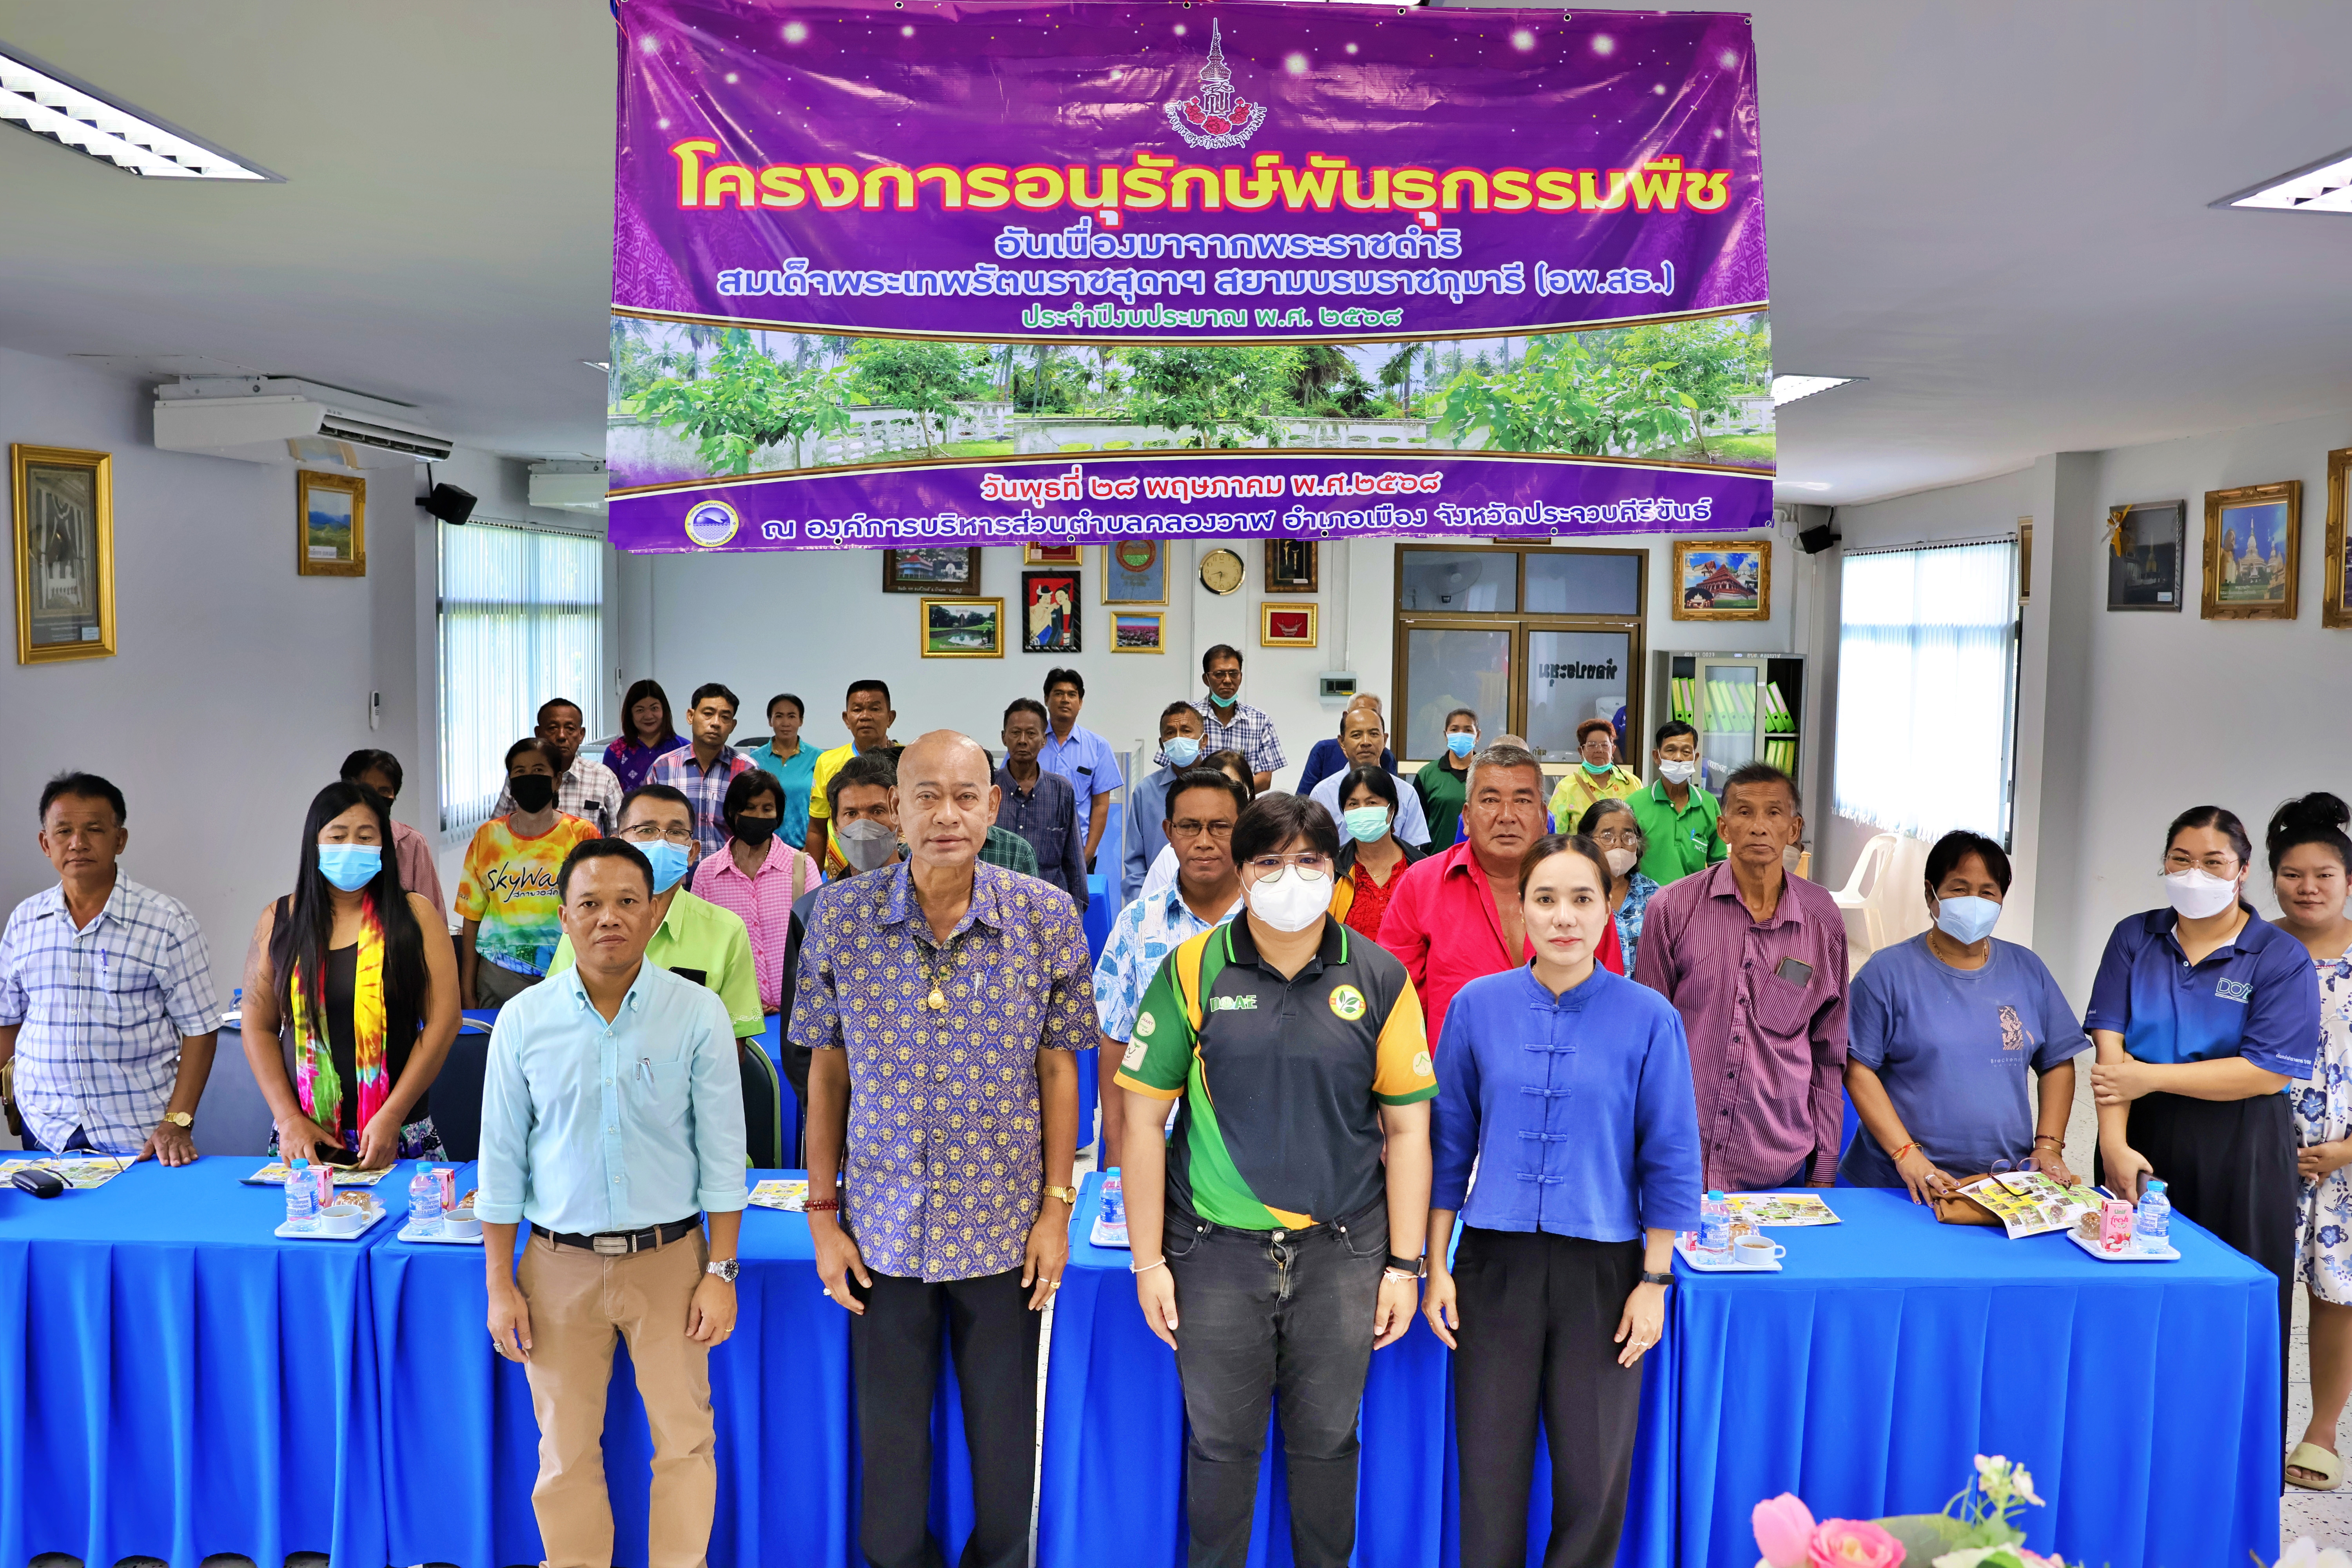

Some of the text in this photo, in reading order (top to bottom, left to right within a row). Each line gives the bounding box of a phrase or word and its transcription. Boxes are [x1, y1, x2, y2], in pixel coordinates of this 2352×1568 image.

[671, 140, 1728, 226] โครงการอนุรักษ์พันธุกรรมพืช
[996, 218, 1461, 259] อันเนื่องมาจากพระราชดำริ
[717, 257, 1674, 304] สมเด็จพระเทพรัตนราชสุดาฯ สยามบรมราชกุมารี (อพ.สธ.)
[1022, 301, 1403, 328] ประจำปีงบประมาณ พ.ศ. ๒๕๖๘
[981, 464, 1442, 508] วันพุธที่ ๒๘ พฤษภาคม พ.ศ.๒๕๖๘
[762, 496, 1713, 541] ณ องค์การบริหารส่วนตำบลคลองวาฬ อำเภอเมือง จังหวัดประจวบคีรีขันธ์
[487, 861, 559, 903] SkyWa
[2111, 1215, 2129, 1225] fresh
